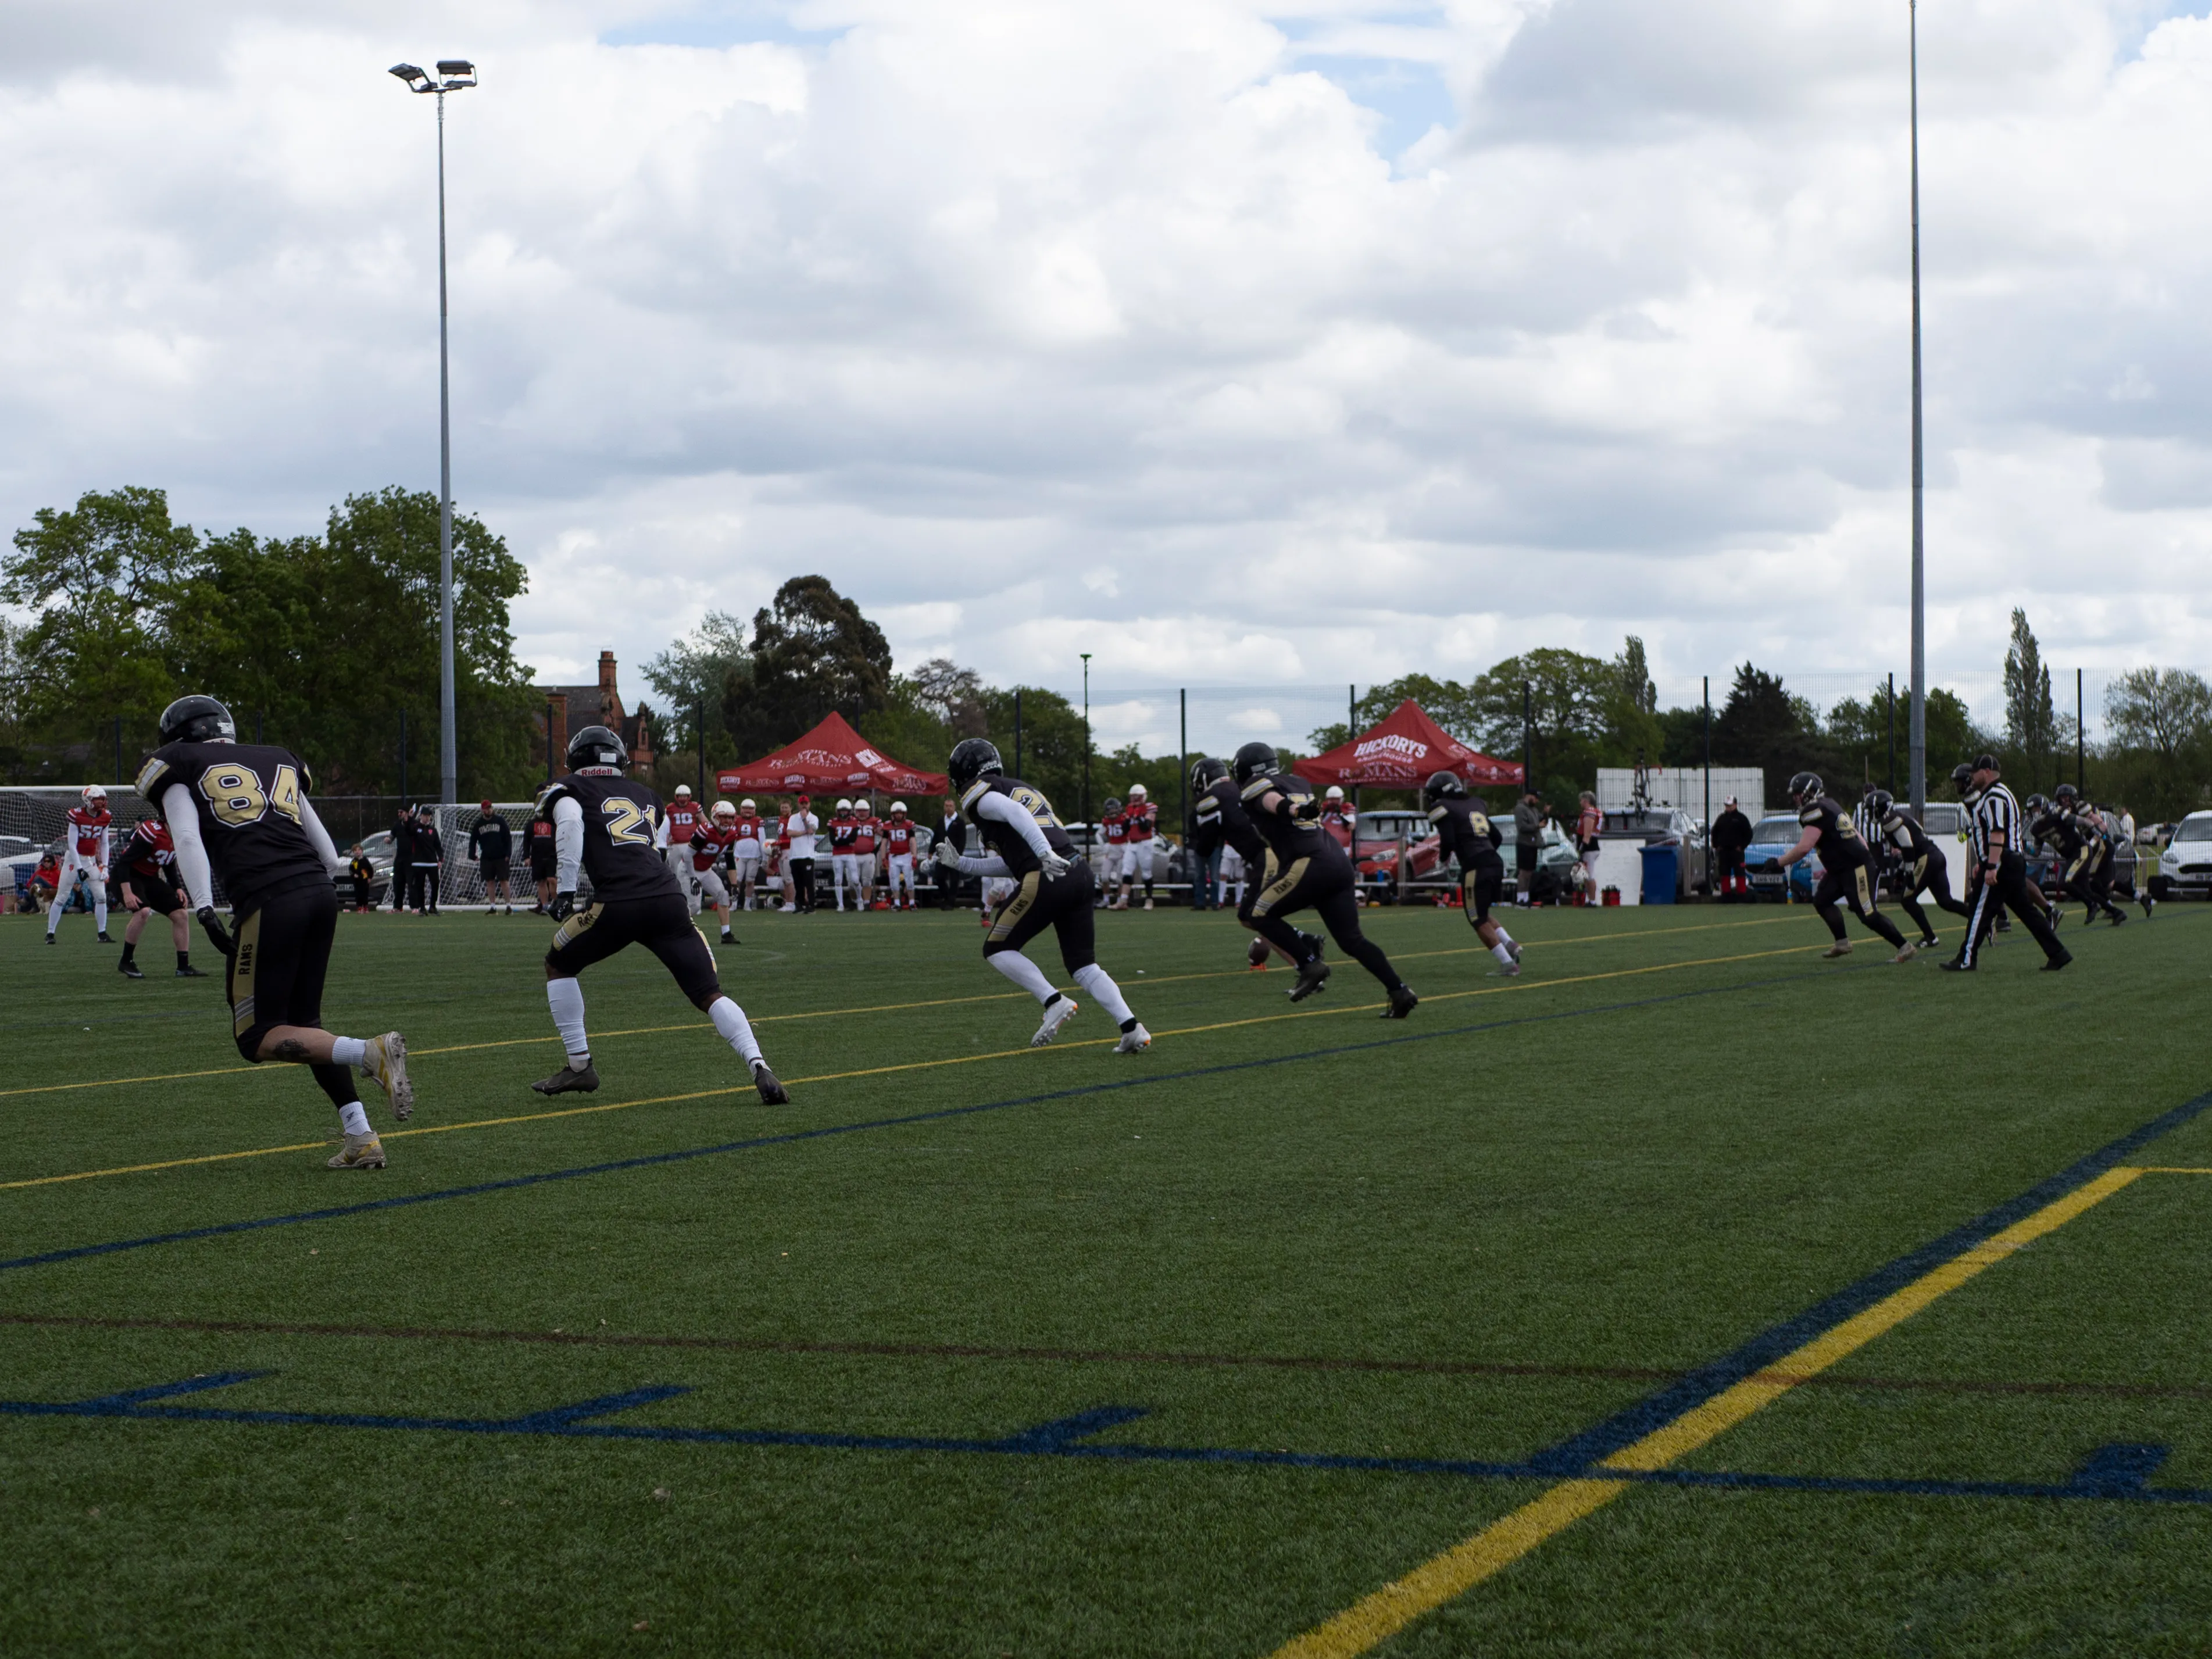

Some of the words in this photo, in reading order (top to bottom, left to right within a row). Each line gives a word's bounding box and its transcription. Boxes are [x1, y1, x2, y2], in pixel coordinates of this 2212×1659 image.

[198, 763, 303, 828] 84
[673, 813, 692, 825] 10
[78, 824, 103, 839] 52
[741, 824, 752, 836] 9
[835, 826, 852, 840] 17
[1108, 824, 1123, 836] 16
[1009, 899, 1029, 916] RAMS
[238, 943, 253, 975] RAMS
